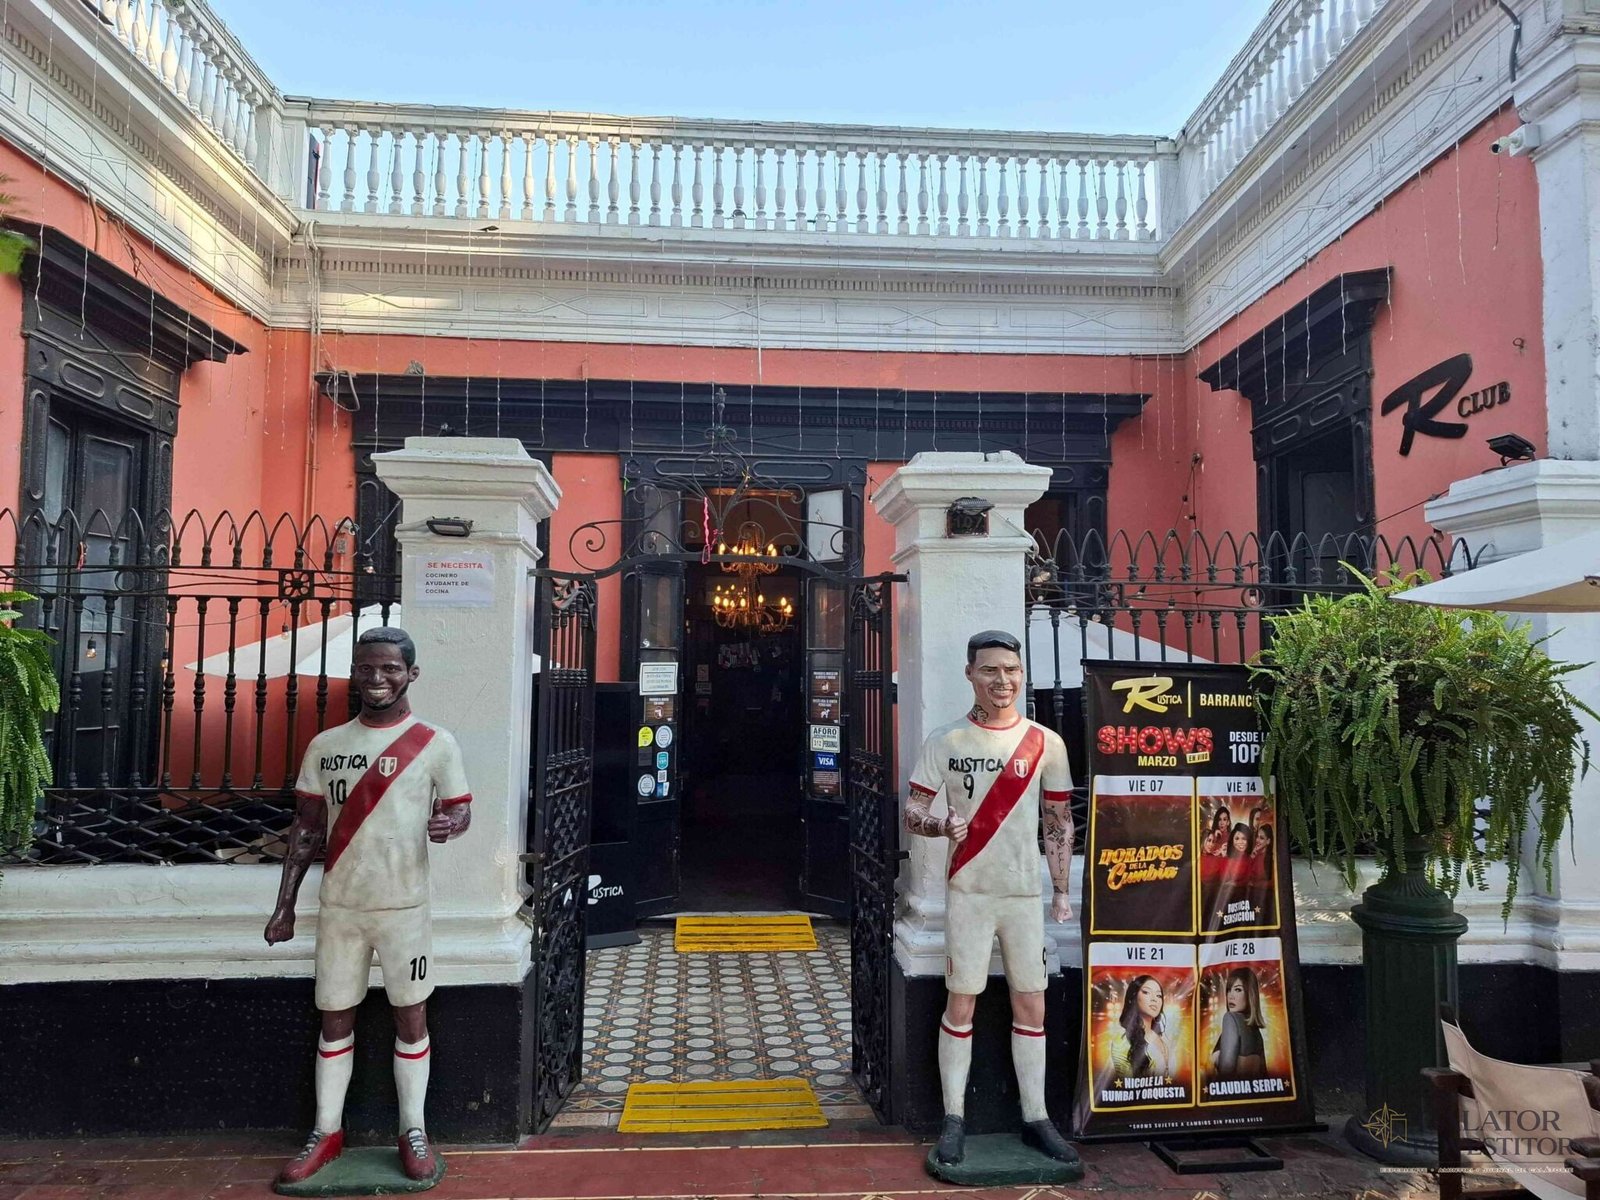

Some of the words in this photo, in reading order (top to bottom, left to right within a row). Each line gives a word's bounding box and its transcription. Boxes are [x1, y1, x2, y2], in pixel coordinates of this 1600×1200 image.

[1457, 381, 1511, 418] CLUB
[1200, 693, 1253, 707] BARRANC
[813, 727, 837, 735] AFORO
[1229, 731, 1259, 742] DESDE
[1097, 725, 1213, 755] SHOWS
[1229, 743, 1274, 763] 10P
[321, 754, 368, 772] RUSTICA
[818, 757, 834, 766] VISA
[949, 757, 1006, 773] RUSTICA
[1138, 755, 1177, 767] MARZO
[328, 779, 347, 806] 10
[963, 773, 975, 800] 9
[1128, 780, 1146, 792] VIE
[1150, 780, 1164, 792] 07
[1226, 782, 1243, 793] VIE
[1246, 781, 1257, 792] 14
[1099, 844, 1184, 866] DORADOS
[1127, 947, 1146, 960] VIE
[1150, 947, 1164, 960] 21
[1225, 943, 1238, 957] VIE
[1242, 942, 1255, 955] 28
[410, 955, 427, 981] 10
[1124, 1076, 1153, 1089] NICOLE
[1154, 1076, 1163, 1086] LA
[1209, 1080, 1252, 1096] CLAUDIA
[1252, 1078, 1284, 1093] SERPA
[1101, 1089, 1134, 1102] RUMBA
[1135, 1089, 1141, 1100] Y
[1141, 1087, 1185, 1100] ORQUESTA
